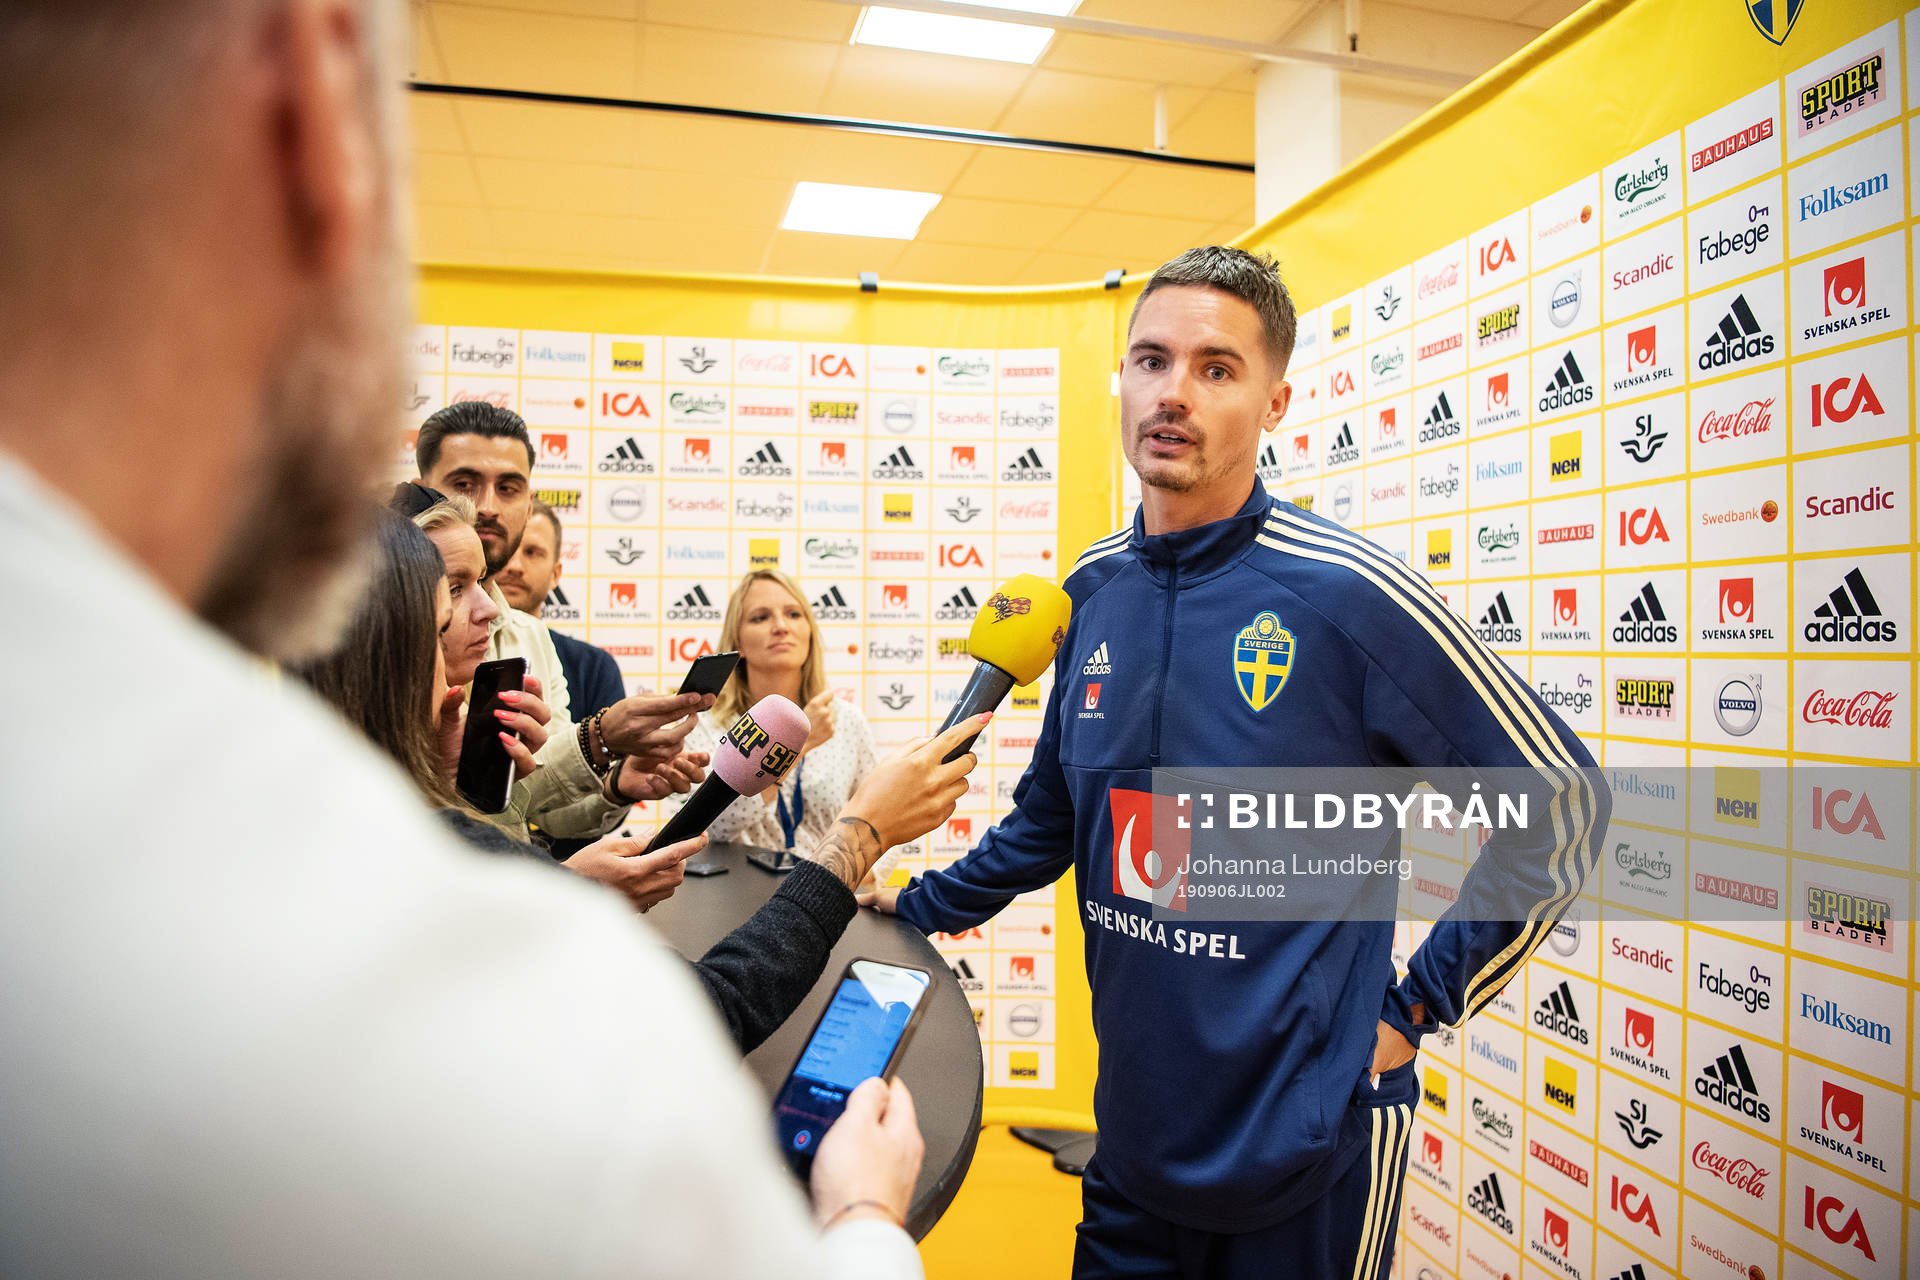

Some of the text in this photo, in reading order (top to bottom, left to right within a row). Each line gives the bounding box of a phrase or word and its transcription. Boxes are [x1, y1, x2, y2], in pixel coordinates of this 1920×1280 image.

[1801, 55, 1882, 121] SPORT
[1806, 89, 1879, 131] BLADET
[1692, 118, 1773, 172] BAUHAUS
[1615, 162, 1668, 203] Carlsberg
[1799, 172, 1888, 222] Folksam
[1480, 237, 1516, 276] ICA
[1700, 222, 1769, 265] Fabege
[1613, 253, 1674, 290] Scandic
[1478, 304, 1519, 339] SPORT
[1804, 307, 1890, 340] SVENSKA SPEL
[811, 354, 856, 378] ICA
[1699, 333, 1774, 370] adidas
[1331, 370, 1354, 398] ICA
[1613, 368, 1673, 392] SVENSKA SPEL
[602, 392, 651, 418] ICA
[1539, 383, 1593, 412] adidas
[1811, 373, 1885, 428] ICA
[1419, 420, 1461, 443] adidas
[1476, 409, 1521, 427] SVENSKA SPEL
[1635, 414, 1653, 437] SJ
[1698, 397, 1776, 444] Coca-Cola
[599, 460, 654, 474] adidas
[739, 463, 792, 477] adidas
[1327, 448, 1359, 466] adidas
[1476, 460, 1522, 481] Folksam
[873, 467, 924, 480] adidas
[1001, 468, 1052, 482] adidas
[1420, 476, 1459, 498] Fabege
[1371, 484, 1406, 502] Scandic
[1806, 487, 1895, 518] Scandic
[1619, 506, 1670, 546] ICA
[1702, 508, 1759, 526] Swedbank
[1478, 526, 1519, 553] Carlsberg
[1538, 524, 1594, 544] BAUHAUS
[938, 544, 984, 568] ICA
[667, 607, 721, 620] adidas
[816, 608, 856, 620] didas
[935, 608, 977, 620] adida
[1243, 640, 1284, 650] SVERIGE
[1475, 624, 1521, 642] adidas
[1541, 631, 1591, 640] SVENSKA SPEL
[1613, 618, 1677, 643] adidas
[1702, 628, 1774, 640] SVENSKA SPEL
[1805, 616, 1897, 643] adidas
[1083, 662, 1111, 675] adidas
[1540, 683, 1592, 714] Fabege
[1616, 678, 1674, 709] SPORT
[1721, 699, 1755, 711] VOLVO
[1803, 689, 1898, 729] Coca-Cola
[1619, 707, 1671, 718] BLADET
[1613, 772, 1675, 800] Folksam
[1812, 786, 1886, 840] ICA
[1615, 843, 1671, 880] Carlsberg
[1695, 873, 1778, 910] BAUHAUS
[1807, 887, 1891, 938] SPORT
[1086, 900, 1246, 961] SVENSKA SPEL
[1811, 921, 1886, 946] BLADET
[1612, 937, 1673, 973] Scandic
[1700, 962, 1770, 1014] Fabege
[1534, 1008, 1589, 1045] adidas
[1800, 992, 1892, 1045] Folksam
[1470, 1035, 1518, 1074] Folksam
[1610, 1046, 1671, 1081] SVENSKA SPEL
[1630, 1098, 1648, 1124] SJ
[1694, 1077, 1771, 1123] adidas
[1529, 1139, 1589, 1188] BAUHAUS
[1800, 1126, 1888, 1173] SVENSKA SPEL
[1692, 1141, 1771, 1201] Coca-Cola
[1467, 1192, 1514, 1235] adidas
[1611, 1175, 1661, 1238] ICA
[1804, 1184, 1877, 1262] ICA
[1531, 1240, 1581, 1280] SVENSKA SPEL
[1690, 1235, 1747, 1275] Swedbank
